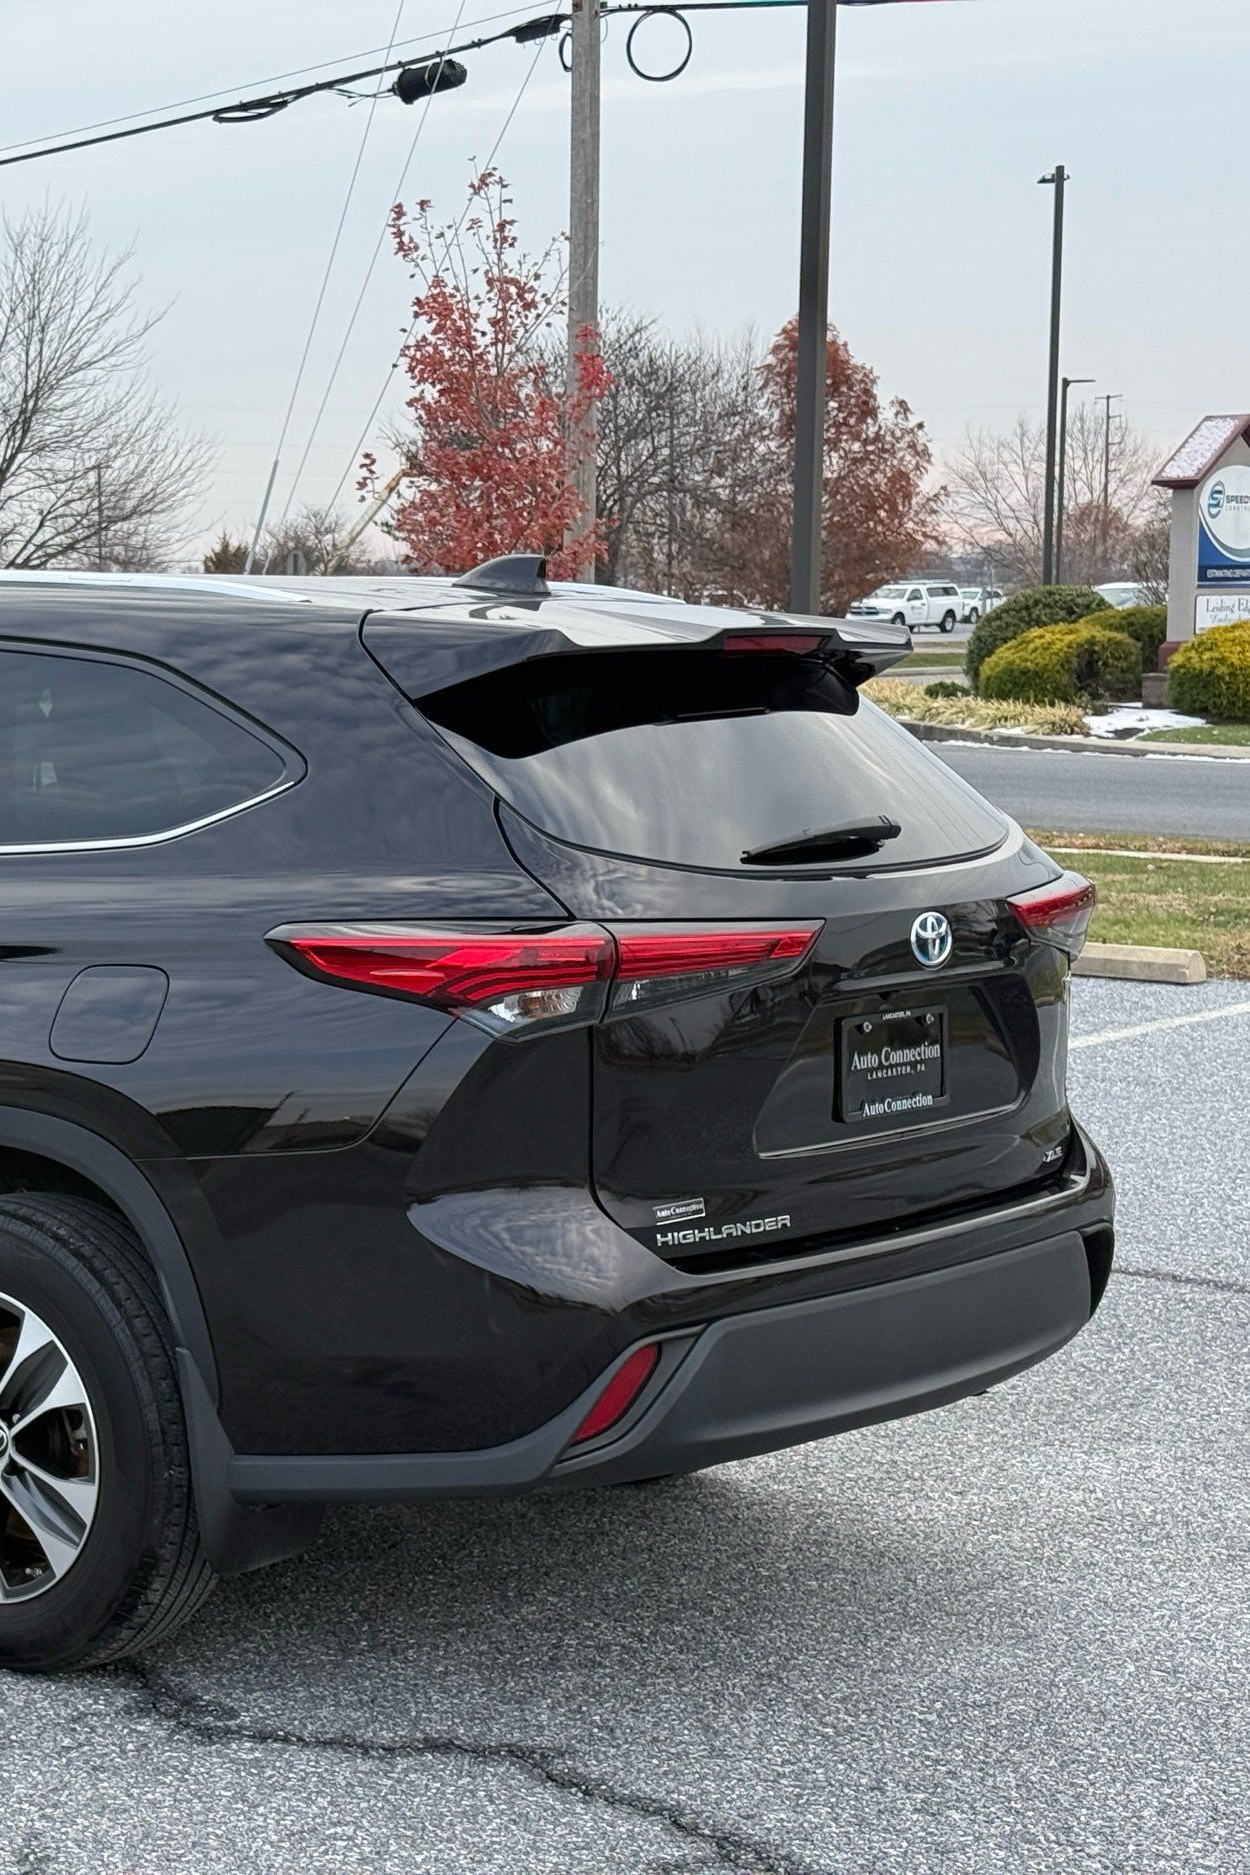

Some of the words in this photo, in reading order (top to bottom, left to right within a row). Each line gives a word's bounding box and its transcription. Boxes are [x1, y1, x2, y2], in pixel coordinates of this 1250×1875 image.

[1226, 494, 1250, 505] SPEED
[851, 1051, 879, 1071] Auto
[881, 1041, 941, 1066] Connection
[867, 1065, 914, 1080] LANCASTER,
[917, 1063, 926, 1072] PA
[1042, 1146, 1063, 1162] XLE
[656, 1214, 791, 1247] HIGHLANDER
